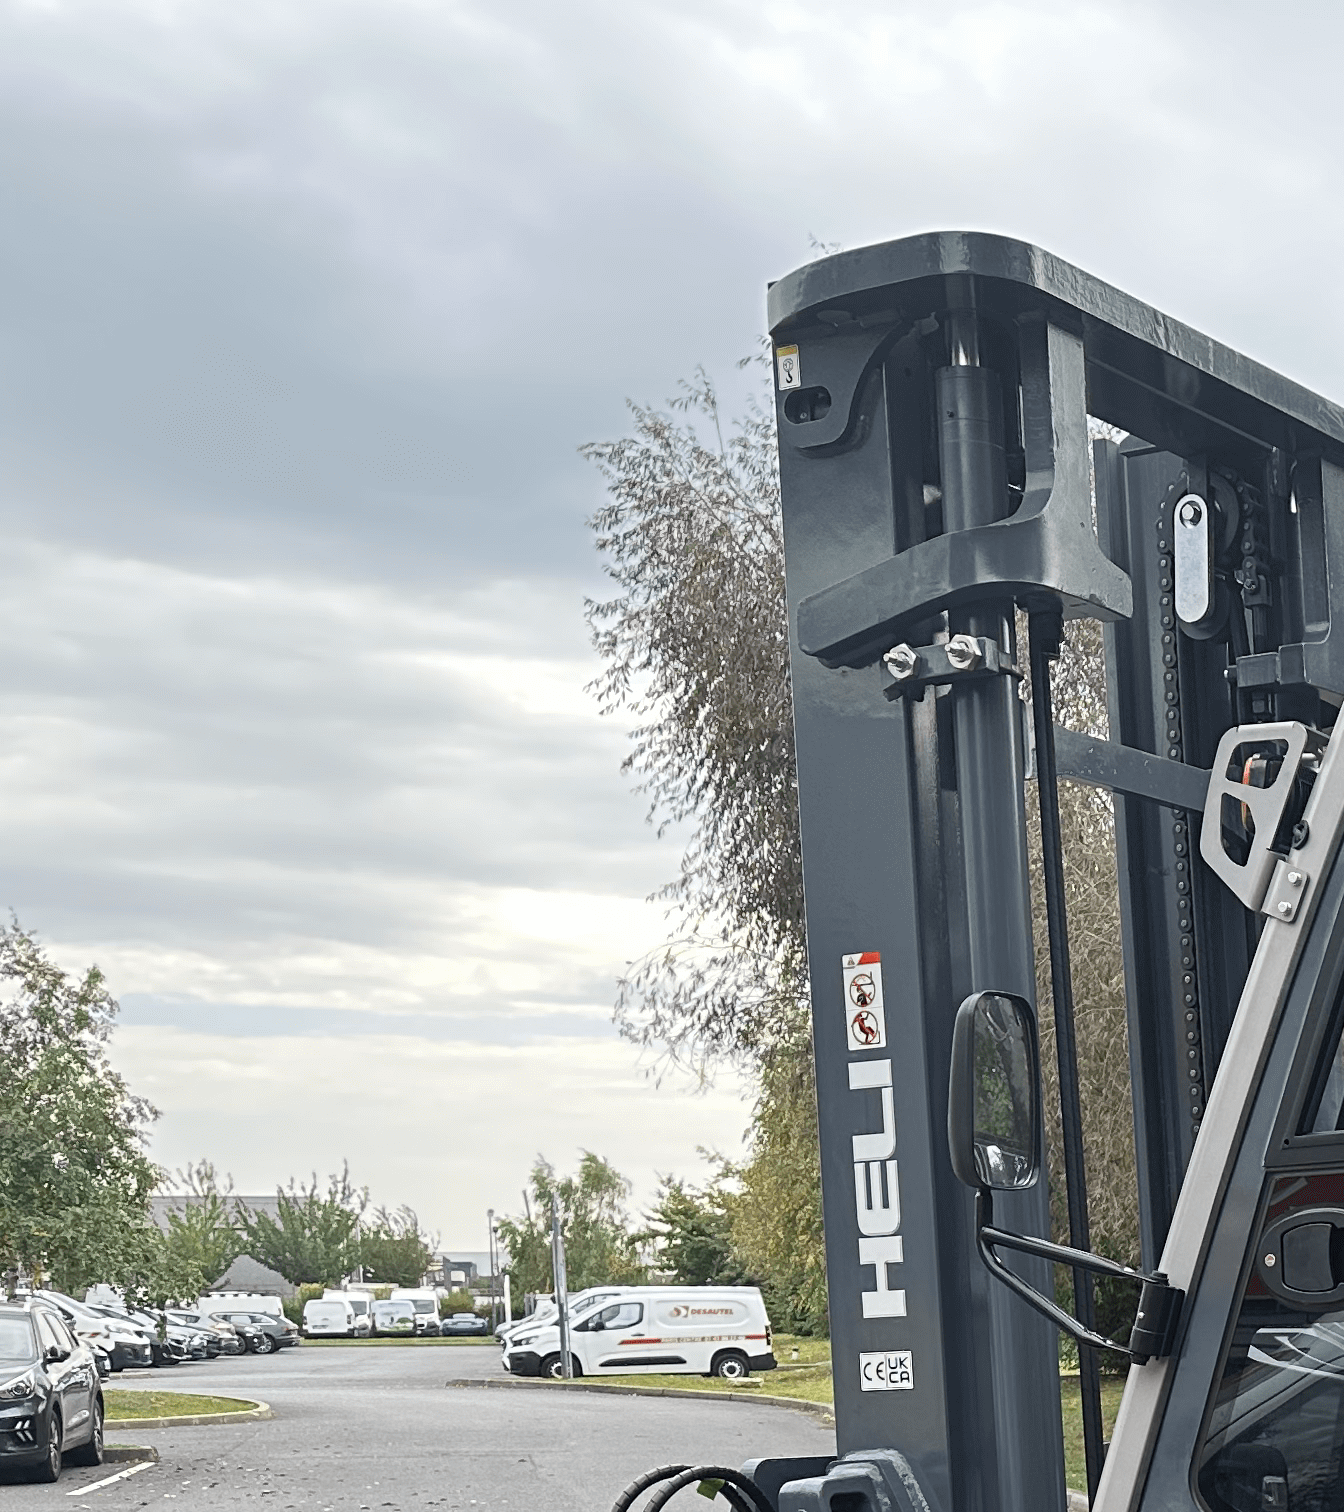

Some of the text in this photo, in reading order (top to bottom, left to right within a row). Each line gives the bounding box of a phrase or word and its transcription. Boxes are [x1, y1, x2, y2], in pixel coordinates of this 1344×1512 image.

[847, 1058, 907, 1319] HELI
[690, 1307, 734, 1316] DESAUTEL
[888, 1356, 909, 1369] UK
[863, 1361, 886, 1382] CE
[889, 1370, 910, 1383] CA
